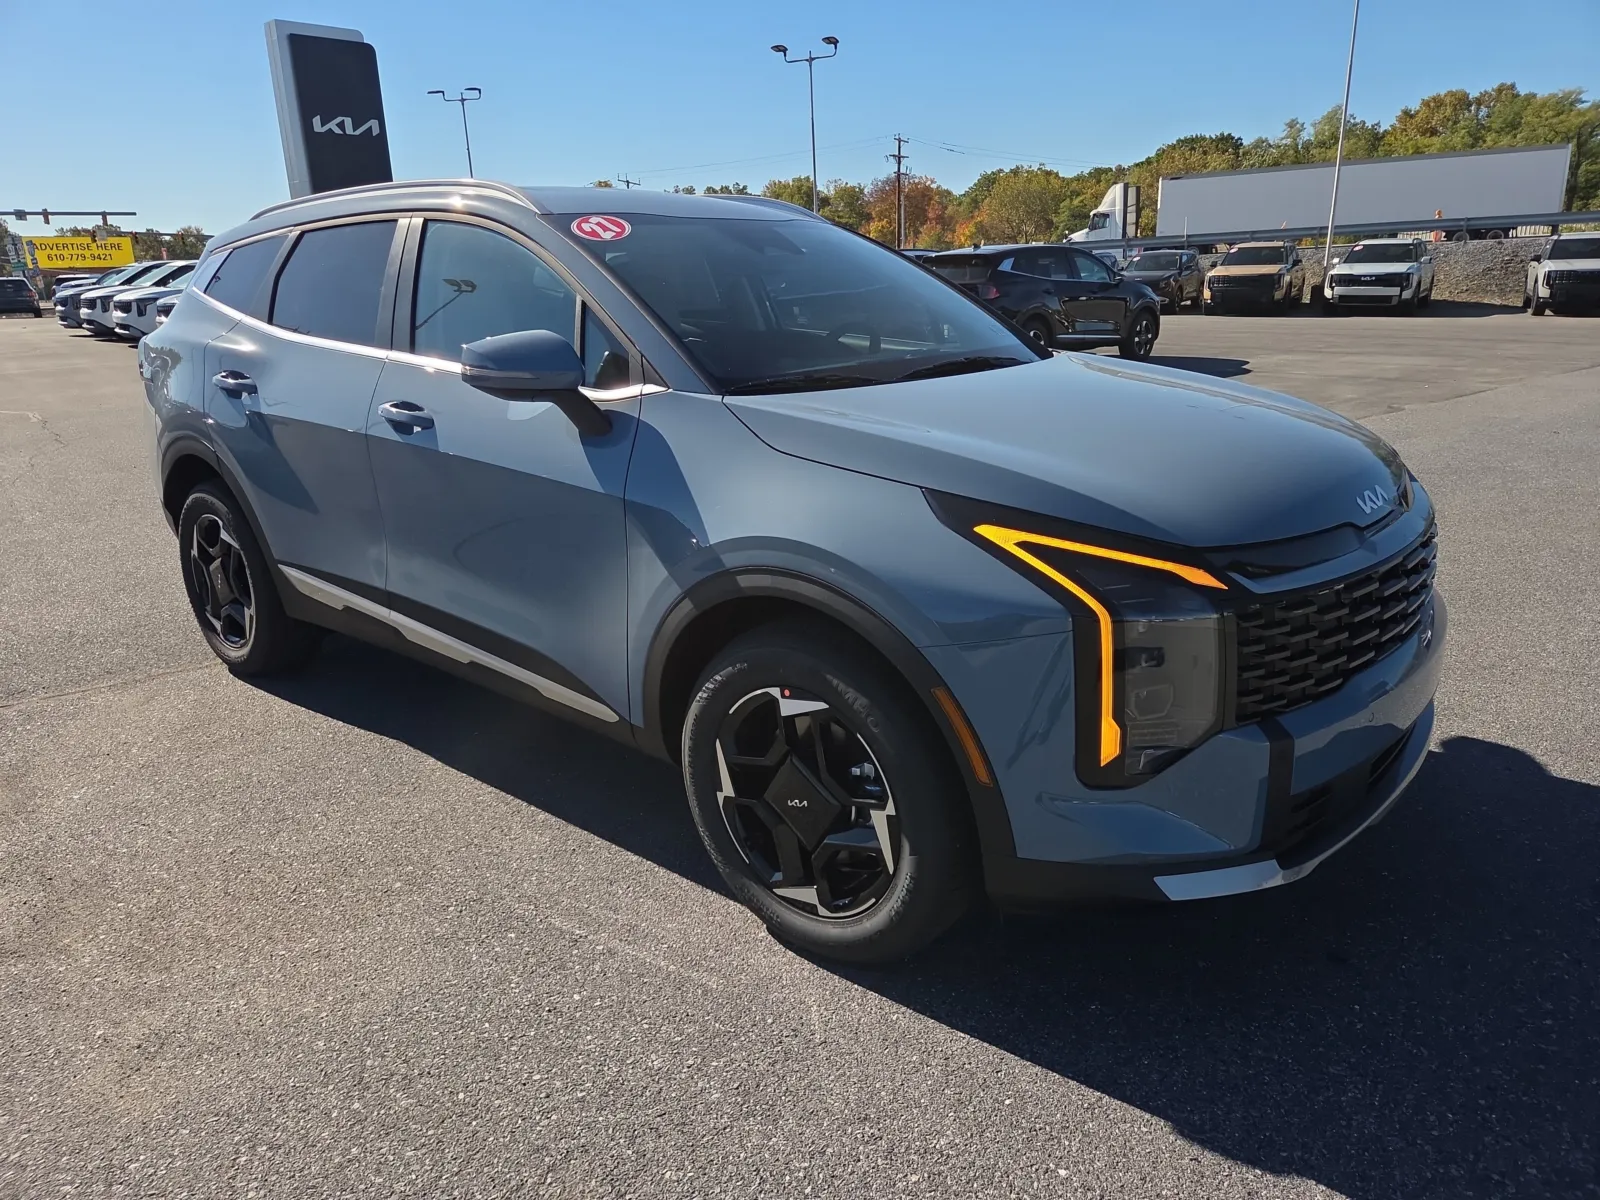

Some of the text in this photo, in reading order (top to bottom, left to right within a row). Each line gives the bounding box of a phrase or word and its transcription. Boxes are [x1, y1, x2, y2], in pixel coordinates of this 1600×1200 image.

[312, 114, 380, 137] KIA
[33, 243, 93, 251] ADVERTISE
[96, 243, 123, 251] HERE
[47, 253, 113, 261] 610-779-9421
[1356, 484, 1389, 514] KIA
[787, 799, 808, 808] KIA
